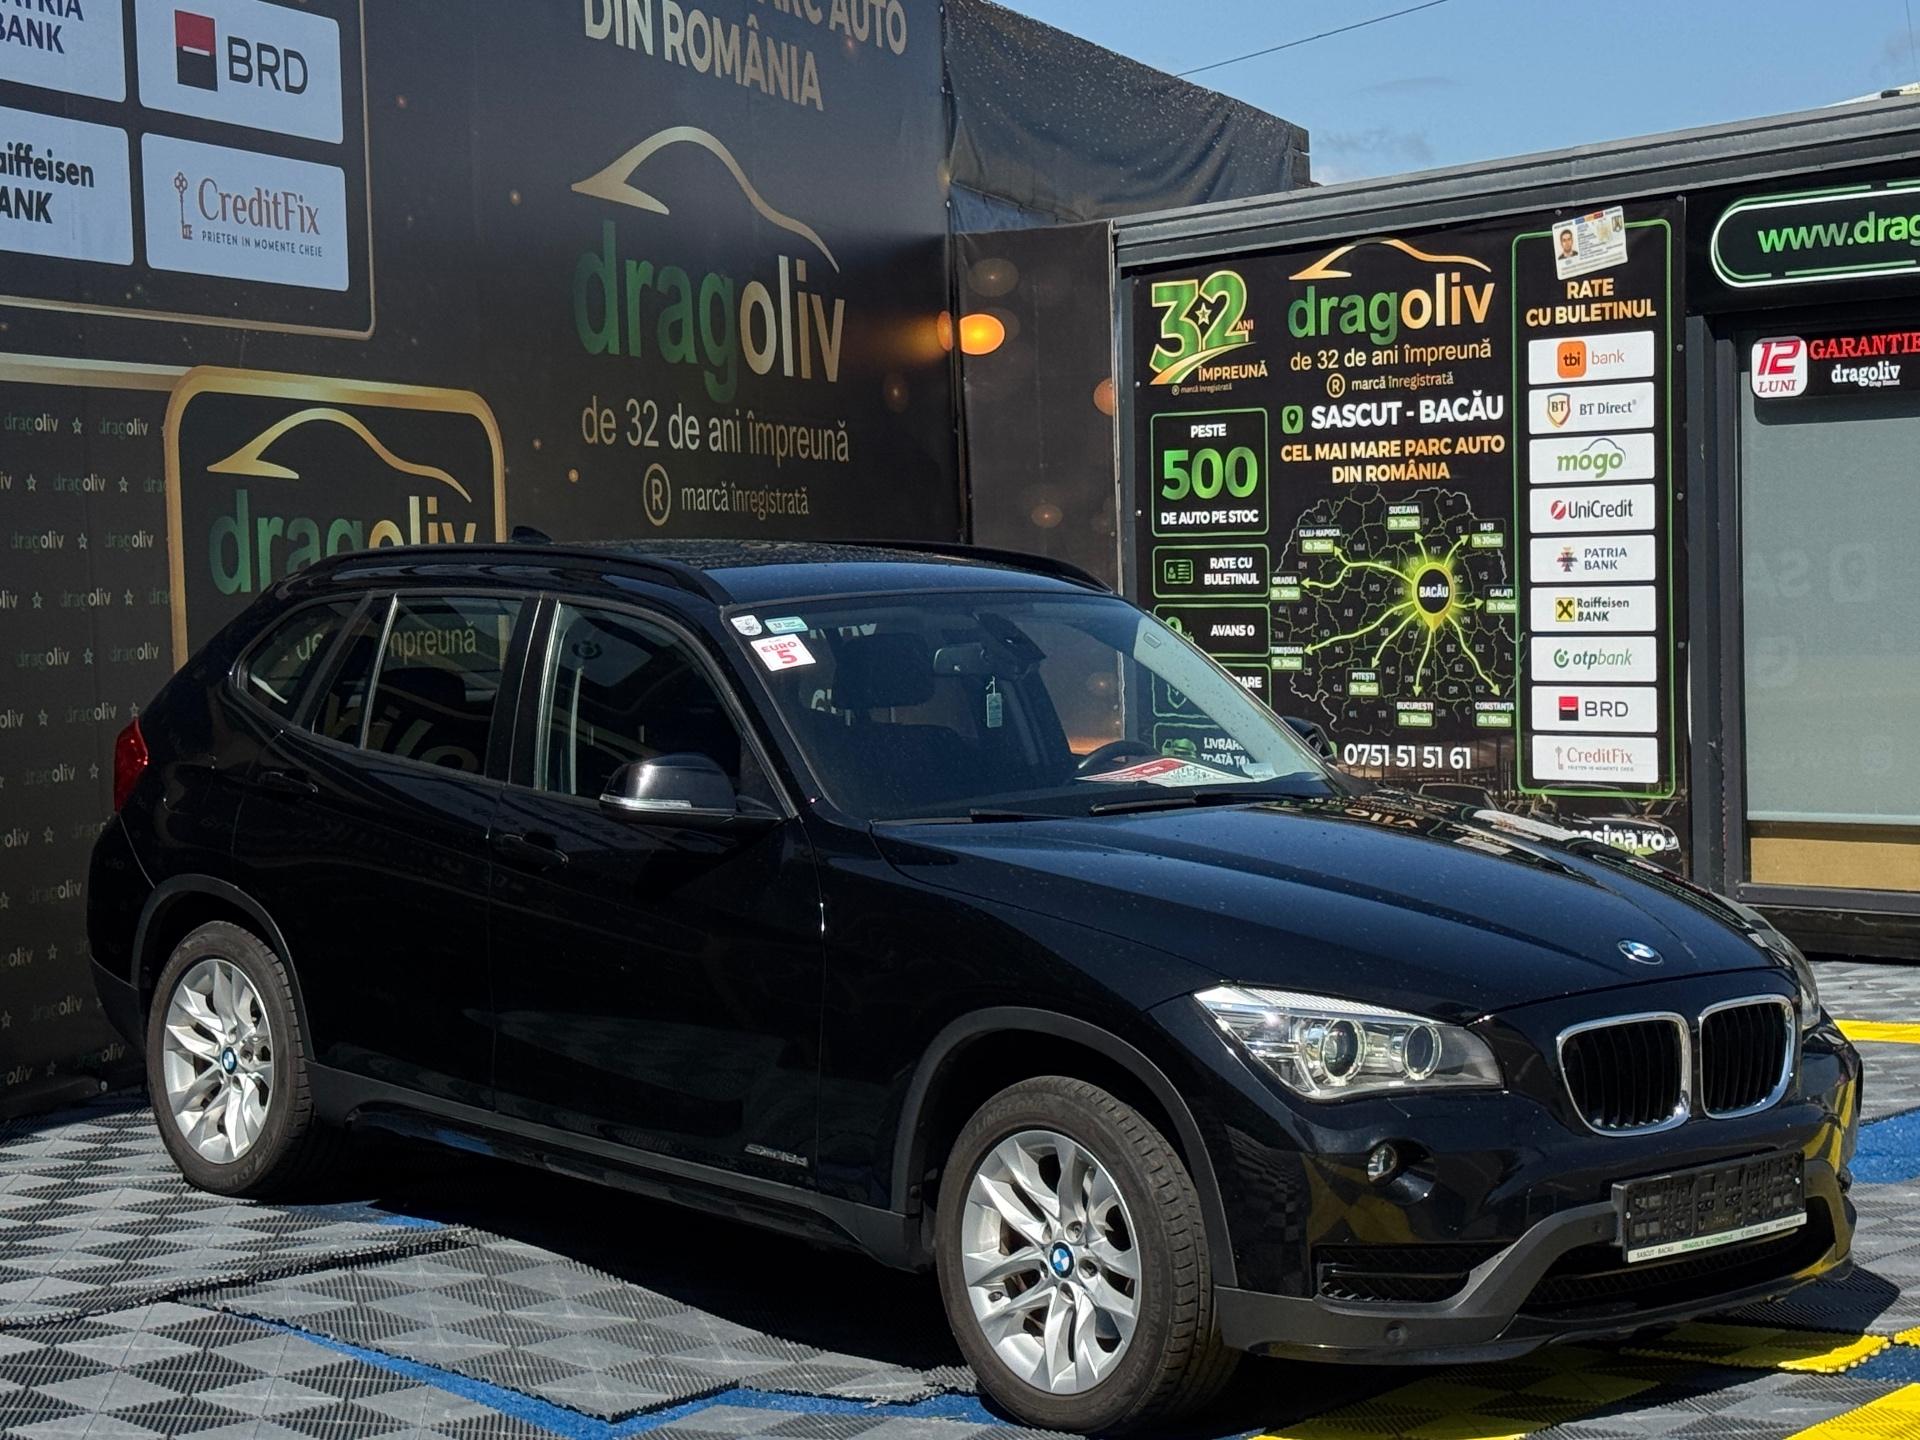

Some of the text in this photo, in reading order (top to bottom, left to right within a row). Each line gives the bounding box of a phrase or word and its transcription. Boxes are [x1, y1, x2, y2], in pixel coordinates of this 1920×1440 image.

[829, 0, 907, 55] AUTO
[227, 36, 309, 95] BRD
[585, 0, 823, 111] DIN ROMÂNIA
[199, 178, 320, 235] CreditFix
[202, 230, 323, 258] PRIETEN IN MOMENTE CHEIE
[1566, 278, 1614, 299] RATE
[573, 219, 845, 402] dragoliv
[1287, 272, 1495, 345] dragoliv
[1525, 299, 1657, 327] CU BULETINUL
[1149, 270, 1250, 374] 32
[1235, 320, 1254, 332] ANI
[1290, 338, 1492, 371] de 32 de ani împreună
[1563, 349, 1625, 366] tbi bank
[1758, 340, 1801, 375] 12
[1199, 360, 1268, 382] ÎMPREUNĂ
[1831, 361, 1901, 387] dragoliv
[1351, 375, 1387, 391] marcă
[1388, 372, 1455, 392] înregistrată
[1758, 379, 1797, 393] LUNI
[1311, 401, 1402, 429] SASCUT
[1418, 390, 1505, 424] BACĂU
[1552, 401, 1566, 413] BT
[1579, 403, 1595, 416] BT
[5, 413, 58, 436] dragoliv
[99, 417, 149, 440] dragoliv
[581, 396, 849, 468] de 32 de ani împreună
[1190, 423, 1227, 439] PESTE
[1281, 435, 1505, 462] CEL MAI MARE PARC AUTO
[1162, 446, 1258, 500] 500
[1332, 459, 1450, 484] DIN ROMÂNIA
[1557, 451, 1623, 479] mogo
[54, 473, 106, 496] dragoliv
[681, 482, 729, 512] marcă
[731, 482, 810, 521] înregistrată
[1388, 505, 1420, 514] SUCEAVA
[1568, 499, 1633, 519] UniCredit
[1161, 509, 1259, 525] DE AUTO PE STOC
[11, 531, 64, 553] dragoliv
[105, 531, 154, 552] dragoliv
[208, 488, 477, 595] drali
[1299, 529, 1340, 537] CLUJ-NAPOCA
[1210, 557, 1253, 569] RATE CU
[1584, 547, 1627, 559] PATRIA
[1584, 559, 1618, 571] BANK
[1204, 573, 1260, 585] BULETINUL
[1419, 584, 1449, 598] BACĂU
[1490, 588, 1513, 599] GALAȚI
[1577, 597, 1630, 610] Raiffeisen
[1577, 611, 1609, 622] BANK
[1211, 625, 1246, 636] AVANS
[760, 641, 797, 653] EURO
[776, 649, 798, 665] 5
[1270, 646, 1303, 656] TIMIȘOARA
[1573, 649, 1632, 670] otpbank
[1397, 702, 1434, 712] BUCUREȘTI
[1475, 702, 1515, 712] CONSTANȚA
[1584, 701, 1629, 717] BRD
[1344, 743, 1471, 770] 0751 51 51 61
[1567, 747, 1633, 764] CreditFix
